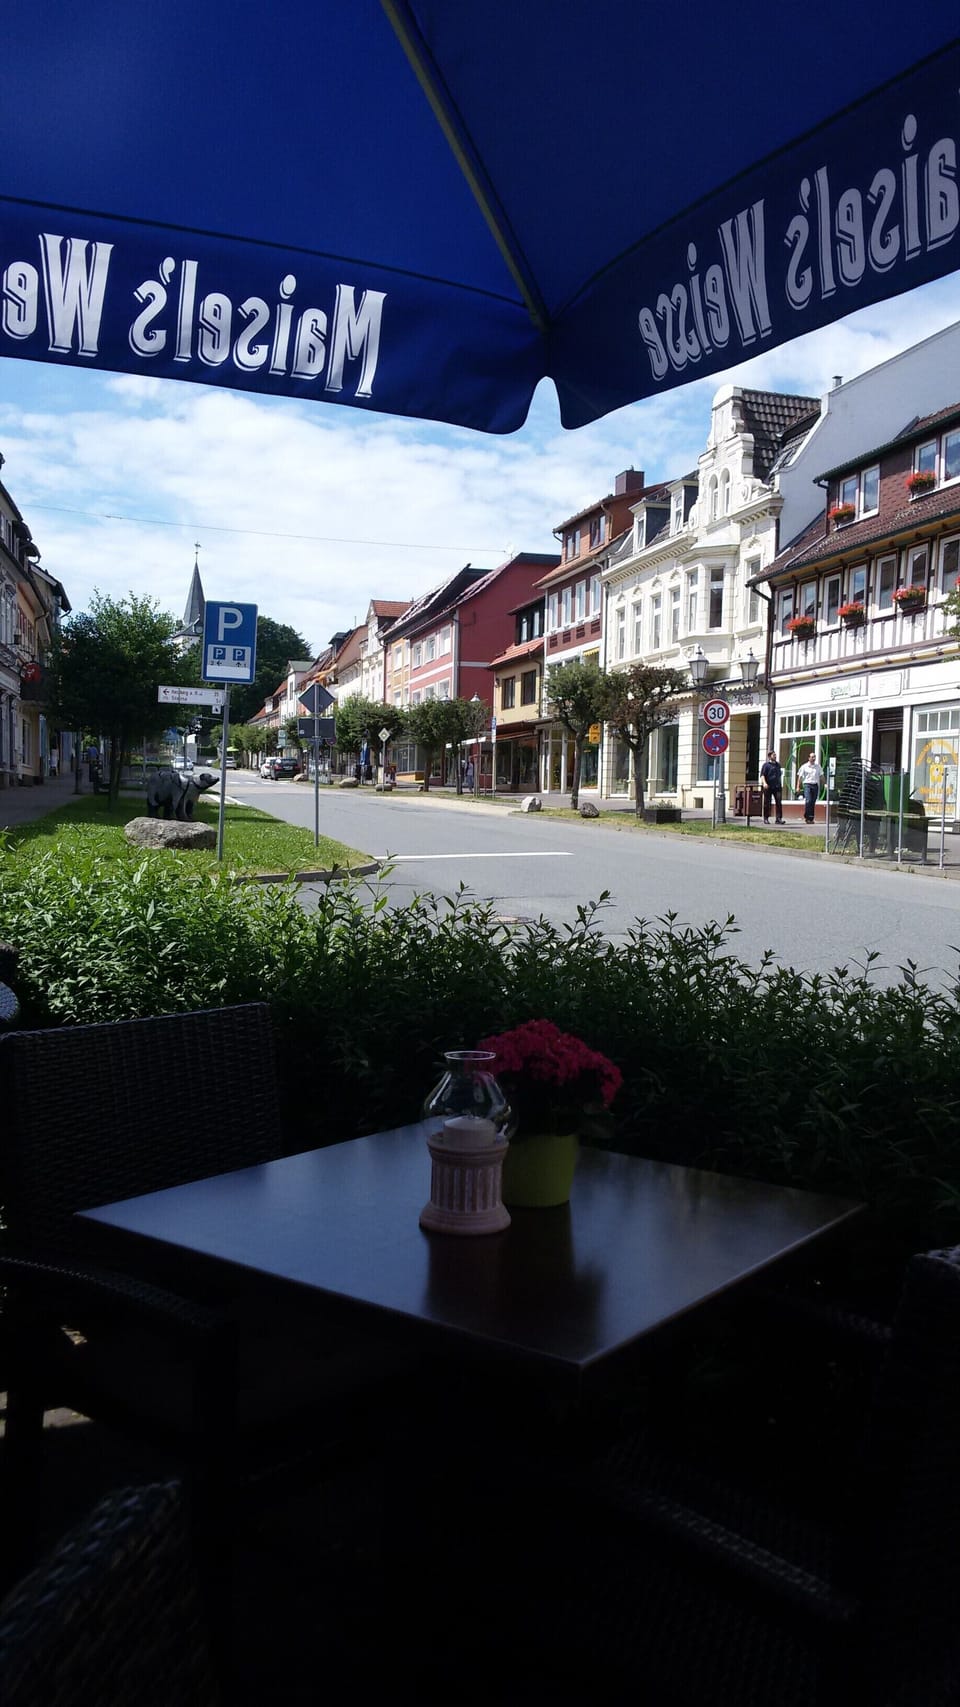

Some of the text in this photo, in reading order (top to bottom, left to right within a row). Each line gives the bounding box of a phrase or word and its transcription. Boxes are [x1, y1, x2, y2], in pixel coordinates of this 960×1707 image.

[218, 606, 243, 641] P
[215, 648, 243, 660] P P
[709, 707, 724, 719] 30
